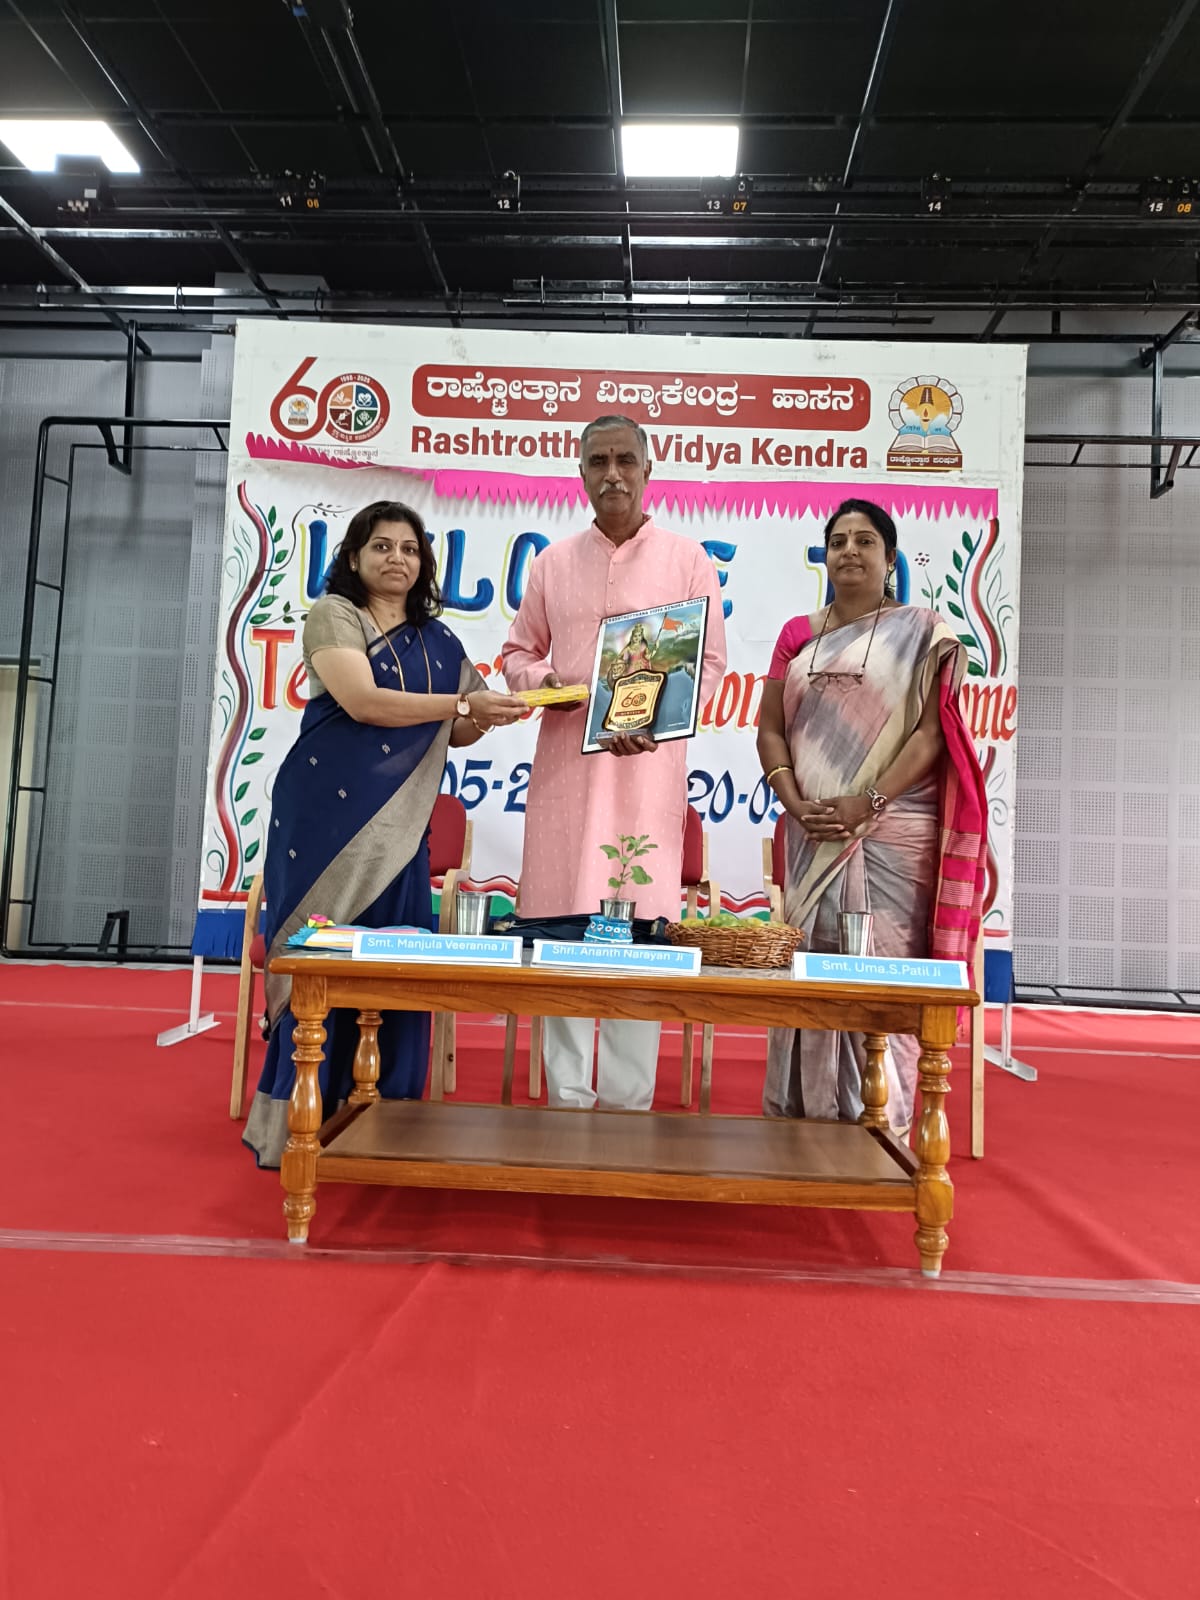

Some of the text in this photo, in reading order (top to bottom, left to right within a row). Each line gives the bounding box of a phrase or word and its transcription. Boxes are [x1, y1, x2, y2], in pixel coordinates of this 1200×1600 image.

[280, 195, 292, 208] 11
[497, 199, 510, 209] 12
[706, 200, 721, 210] 13
[733, 201, 747, 211] 07
[928, 201, 942, 212] 14
[1149, 202, 1164, 212] 15
[1177, 202, 1192, 213] 08
[426, 371, 582, 417] ರಾಷ್ಟ್ರೋತ್ಥಾನ
[771, 383, 854, 411] ಹಾಸನ
[411, 425, 580, 459] Rashtrotth
[650, 433, 741, 471] Vidya
[751, 437, 868, 469] Kendra
[367, 937, 508, 952] Smt. Manjula Veeranna Ji
[552, 945, 684, 961] Shri. Ananth Narayan Ji
[822, 960, 851, 972] Smt.
[933, 966, 941, 977] Ji
